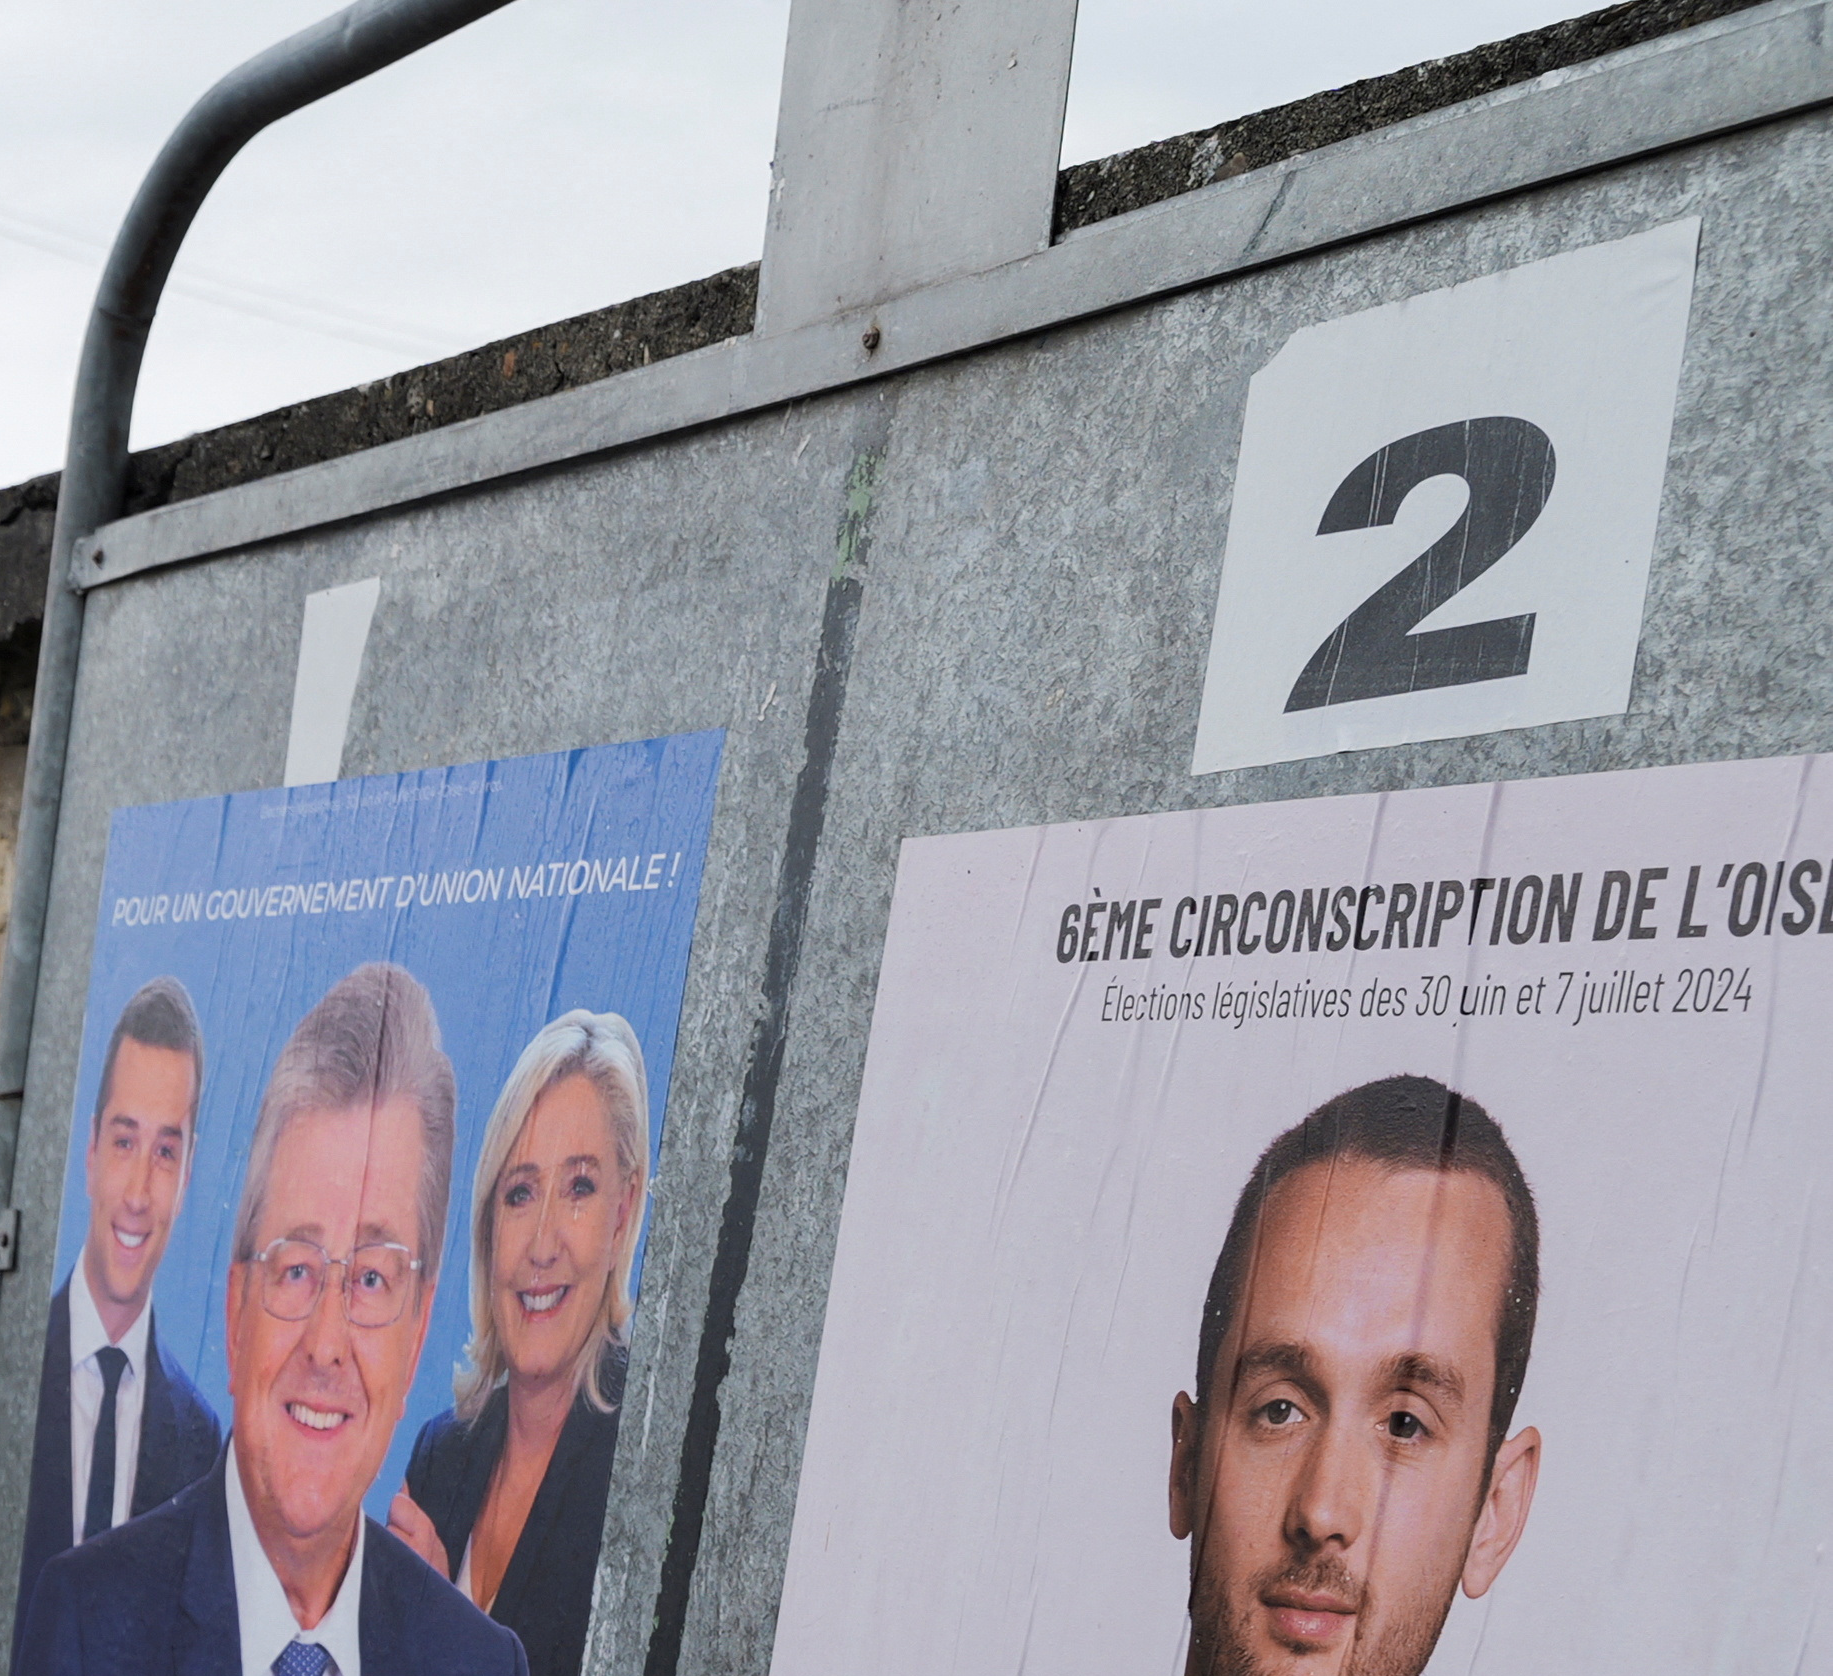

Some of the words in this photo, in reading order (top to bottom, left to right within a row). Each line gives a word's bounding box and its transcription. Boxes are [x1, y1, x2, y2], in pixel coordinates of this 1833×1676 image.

[1283, 416, 1557, 714] 2
[112, 894, 169, 927] POUR
[171, 892, 204, 922] UN
[205, 876, 395, 921] GOUVERNEMENT
[395, 867, 504, 908] D'UNION
[507, 853, 666, 900] NATIONALE
[1056, 887, 1163, 964] 6ÈME
[1169, 872, 1583, 959] CIRCONSCRIPTION
[1591, 867, 1669, 942] DE
[1101, 975, 1206, 1022] Élections
[1212, 978, 1352, 1030] législatives
[1359, 977, 1408, 1018] des
[1415, 975, 1452, 1016] 30
[1452, 973, 1507, 1028] uin
[1515, 973, 1547, 1014] et
[1555, 972, 1575, 1014] 7
[1572, 970, 1666, 1027] juillet
[1672, 967, 1752, 1013] 2024
